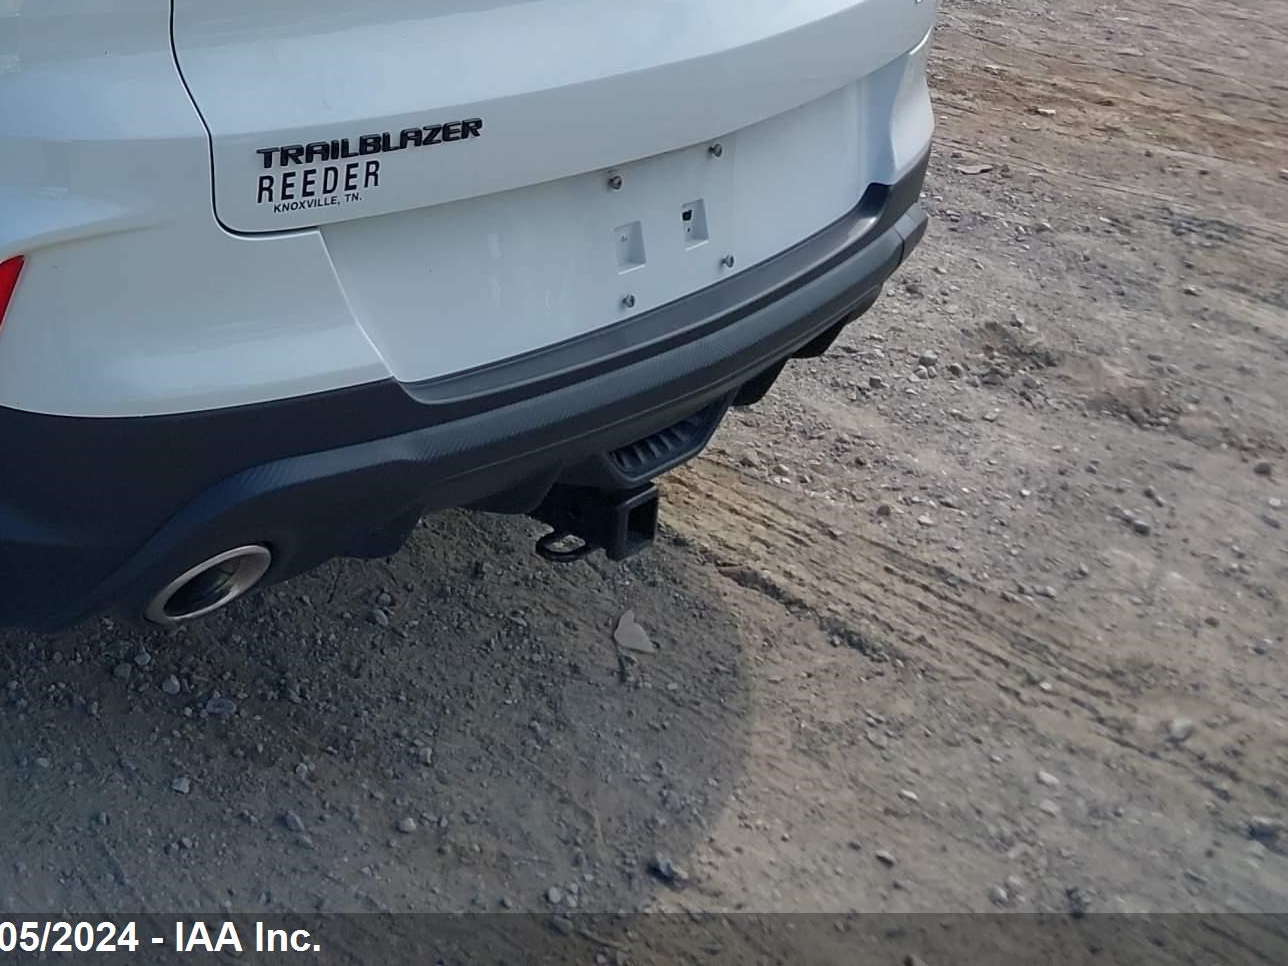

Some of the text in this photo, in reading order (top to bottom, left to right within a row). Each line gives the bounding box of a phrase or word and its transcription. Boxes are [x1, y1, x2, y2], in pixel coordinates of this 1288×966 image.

[256, 117, 484, 169] TRAILBLAZER
[257, 160, 380, 204] REEDER
[272, 191, 363, 214] KNOXVILLE, TN.
